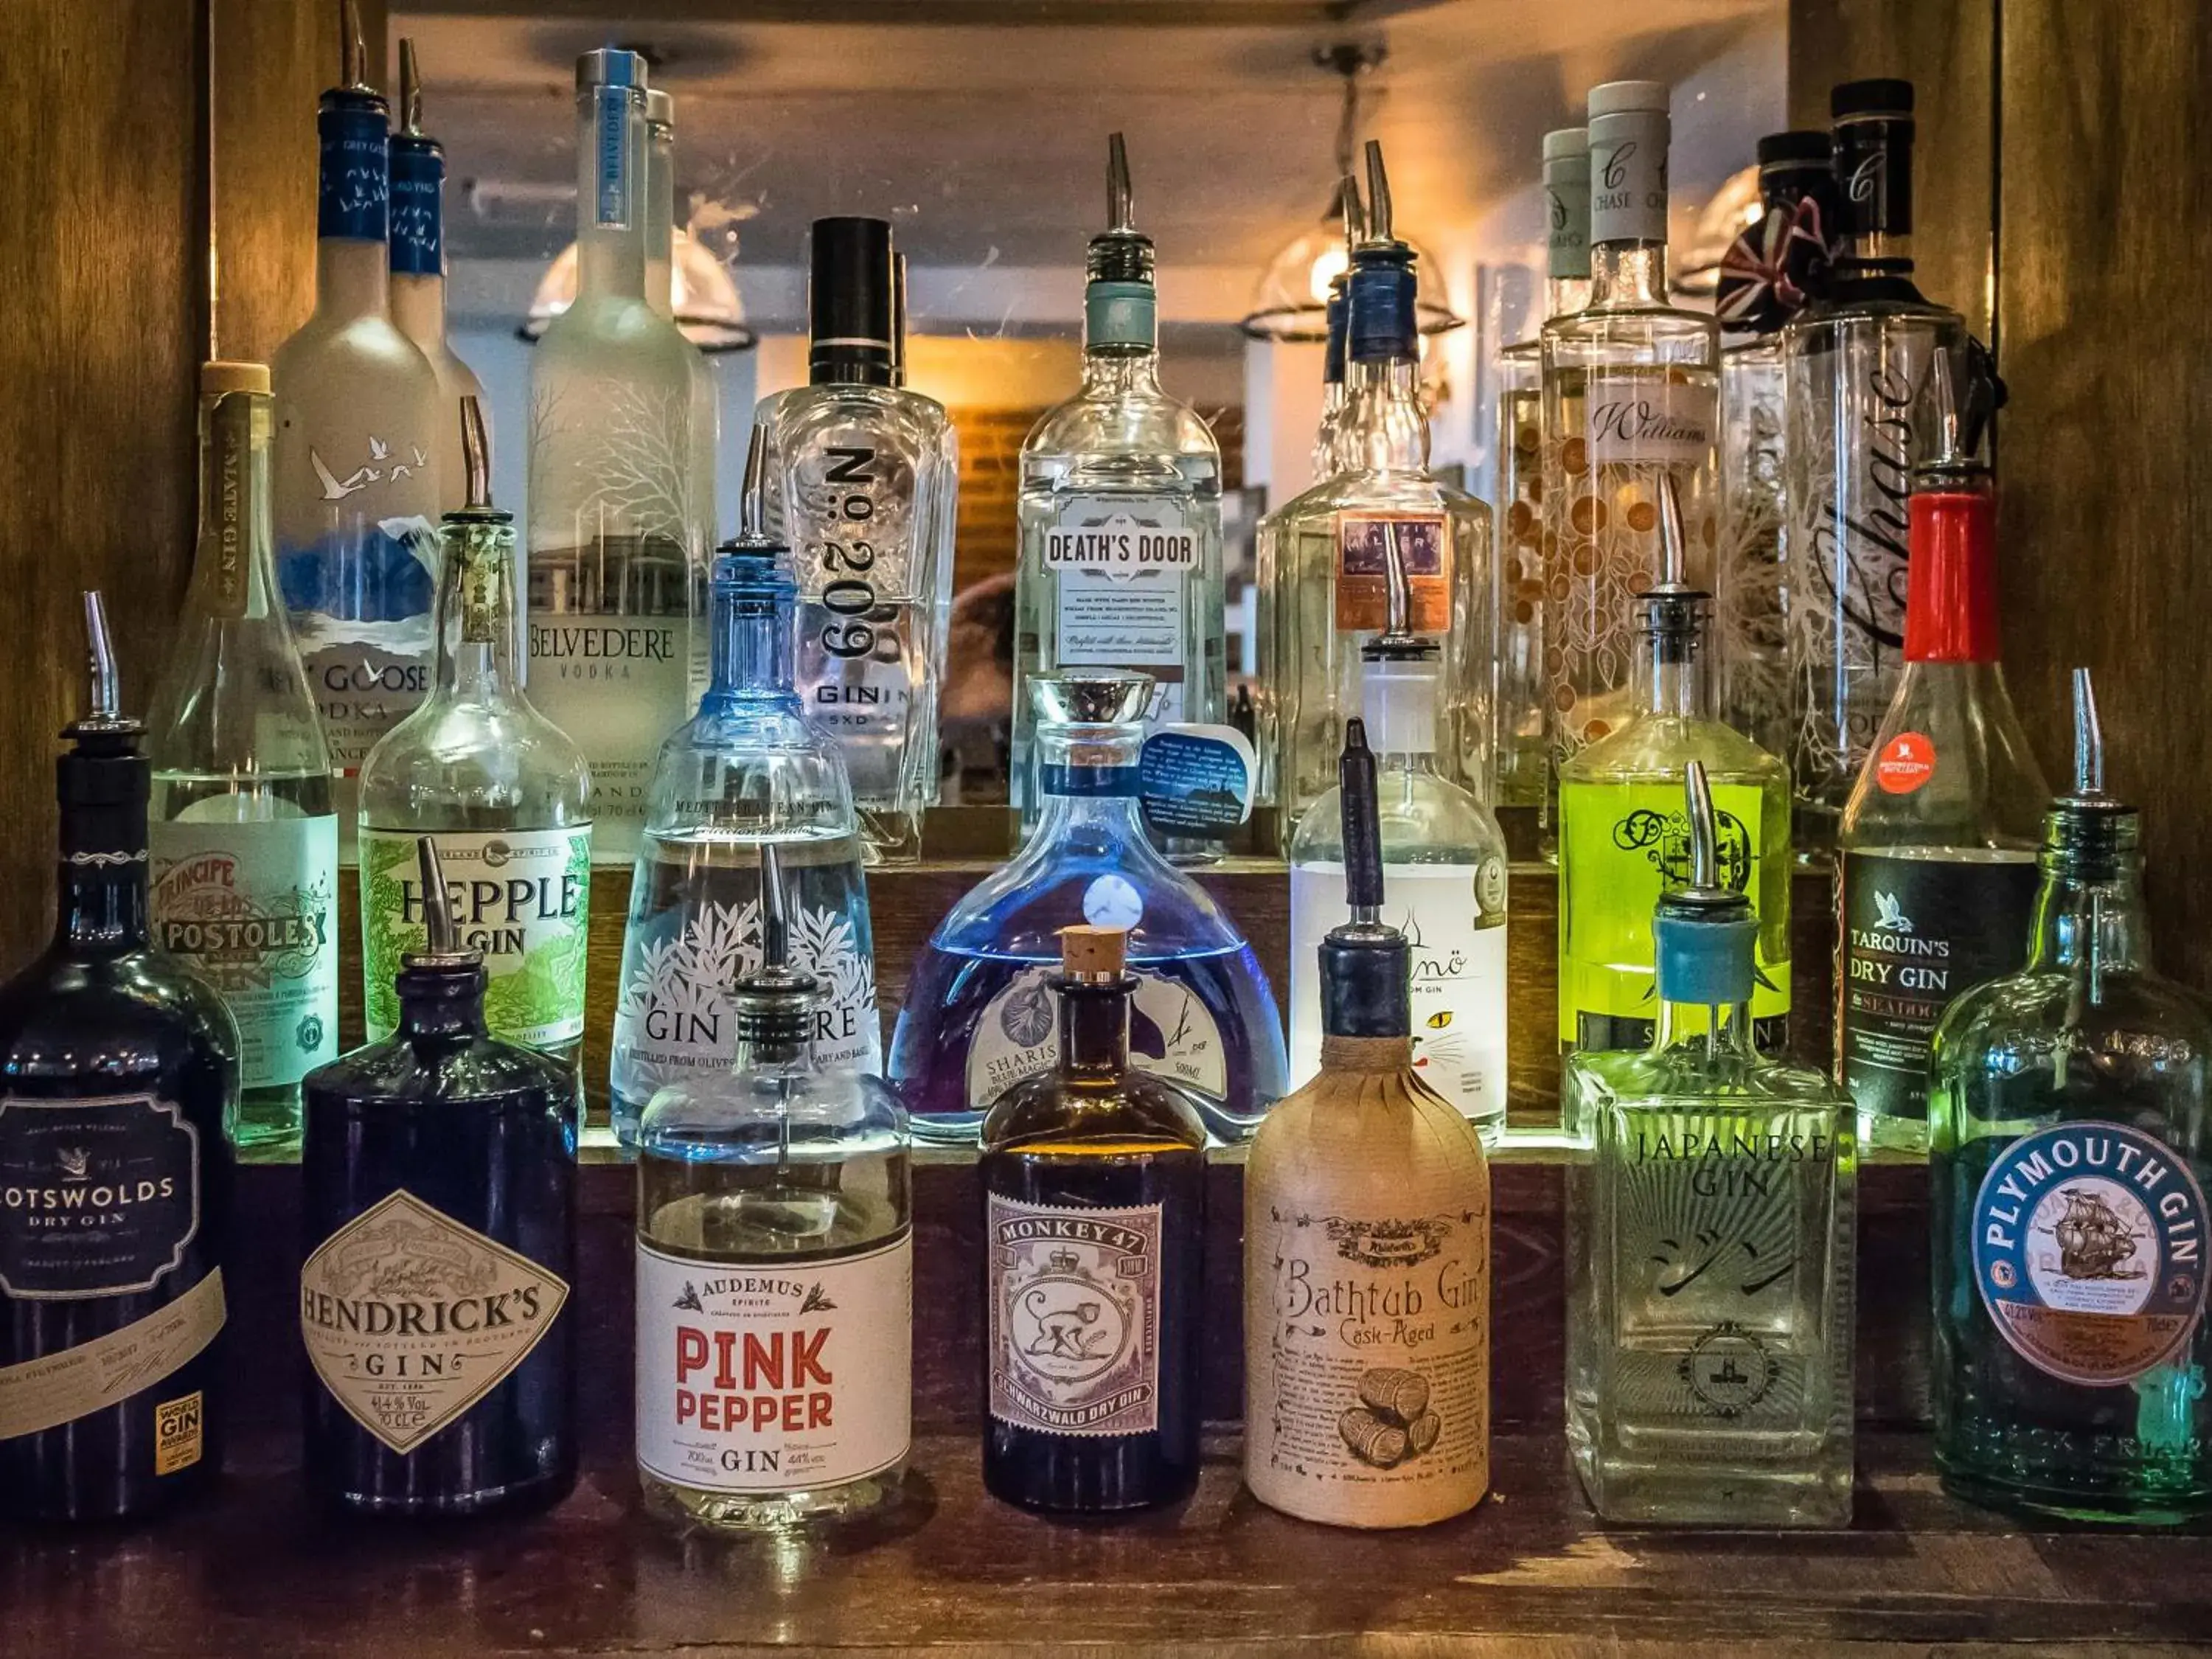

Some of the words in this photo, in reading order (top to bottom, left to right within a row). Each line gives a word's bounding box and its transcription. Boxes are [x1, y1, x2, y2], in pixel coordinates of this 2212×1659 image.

[223, 526, 238, 572] GIN
[1048, 533, 1131, 563] DEATH'S
[1138, 535, 1193, 564] DOOR
[821, 541, 876, 659] 209
[530, 624, 675, 663] BELVEDERE
[324, 664, 428, 692] GOOSE
[560, 664, 631, 681] VODKA
[817, 685, 880, 704] GIN
[400, 873, 579, 925] HEPPLE
[467, 928, 526, 956] GIN
[1850, 928, 1950, 957] TARQUIN'S
[1425, 985, 1443, 994] GIN
[1849, 957, 1894, 984] DRY
[1899, 966, 1950, 991] GIN
[645, 1009, 721, 1044] GIN
[669, 1054, 696, 1066] FROM
[985, 1044, 1057, 1076] SHARIS
[1636, 1131, 1831, 1164] JAPANESE
[4, 1177, 174, 1209] OTSWOLDS
[1692, 1169, 1770, 1197] GIN
[1985, 1136, 2168, 1251] PLYMOUTH
[2159, 1192, 2199, 1265] GIN
[28, 1215, 72, 1227] DRY
[80, 1211, 127, 1227] GIN
[1002, 1220, 1108, 1242] MONKEY
[1111, 1231, 1140, 1249] 47
[702, 1277, 804, 1298] AUDEMUS
[1287, 1257, 1423, 1325] Bathtub
[1437, 1259, 1478, 1310] Gin
[302, 1285, 543, 1337] HENDRICK'S
[1339, 1317, 1436, 1349] Cask-Aged
[365, 1354, 443, 1377] GIN
[676, 1325, 834, 1391] PINK
[676, 1388, 834, 1433] PEPPER
[996, 1374, 1085, 1425] SCHWARZWALD
[1090, 1402, 1117, 1422] DRY
[1120, 1388, 1143, 1407] GIN
[160, 1409, 199, 1437] GIN
[378, 1413, 392, 1426] 70
[720, 1449, 781, 1473] GIN
